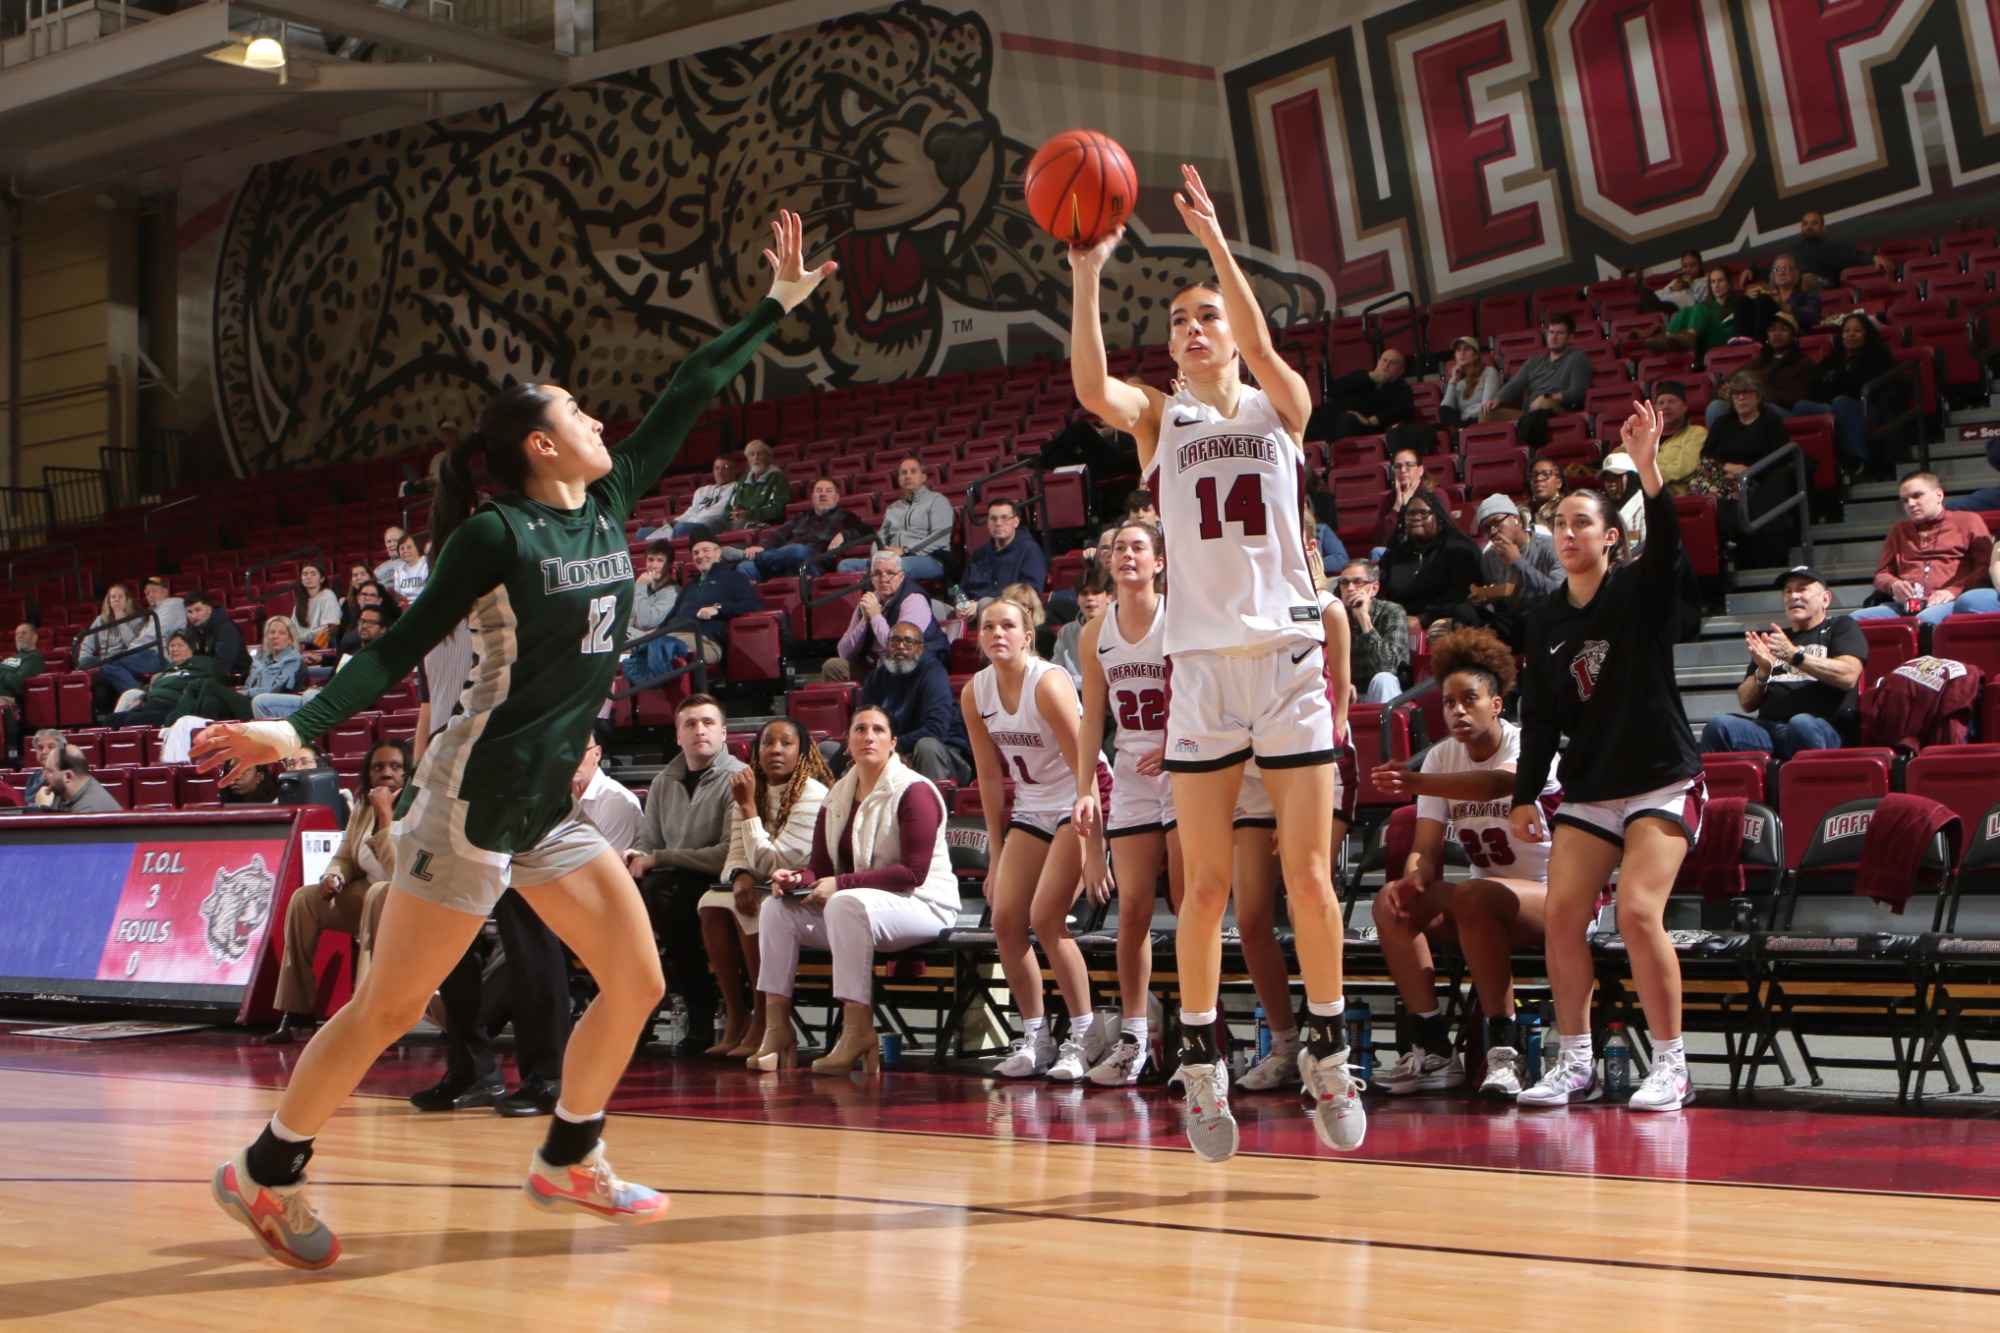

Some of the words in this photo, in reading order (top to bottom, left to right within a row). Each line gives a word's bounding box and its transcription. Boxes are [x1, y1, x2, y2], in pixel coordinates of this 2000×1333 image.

[1247, 0, 2000, 309] LEOP
[952, 318, 973, 333] TM
[1177, 434, 1278, 474] LAFAYETTE
[1195, 474, 1267, 540] 14
[541, 551, 634, 595] LOYOLA
[581, 595, 617, 654] 12
[1116, 689, 1165, 731] 22
[1012, 755, 1042, 785] 1
[410, 849, 434, 882] L
[1459, 827, 1516, 868] 23
[144, 883, 161, 910] 3
[115, 918, 172, 943] FOULS
[125, 950, 140, 977] 0
